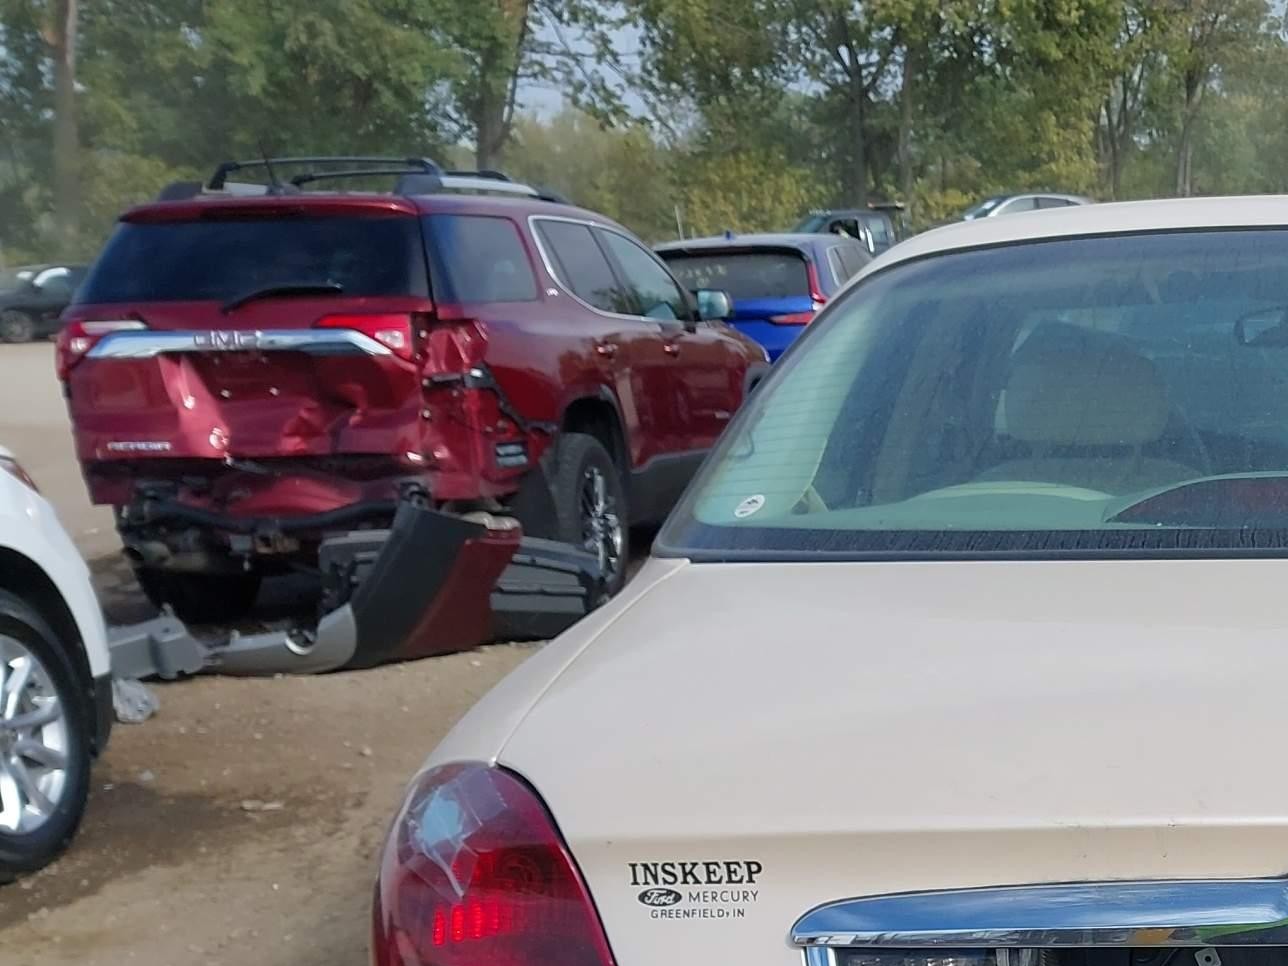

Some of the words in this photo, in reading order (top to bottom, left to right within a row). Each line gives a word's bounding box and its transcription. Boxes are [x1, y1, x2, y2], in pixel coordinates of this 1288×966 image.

[628, 861, 762, 886] INSKEEP
[689, 890, 759, 903] MERCURY
[733, 908, 745, 918] IN
